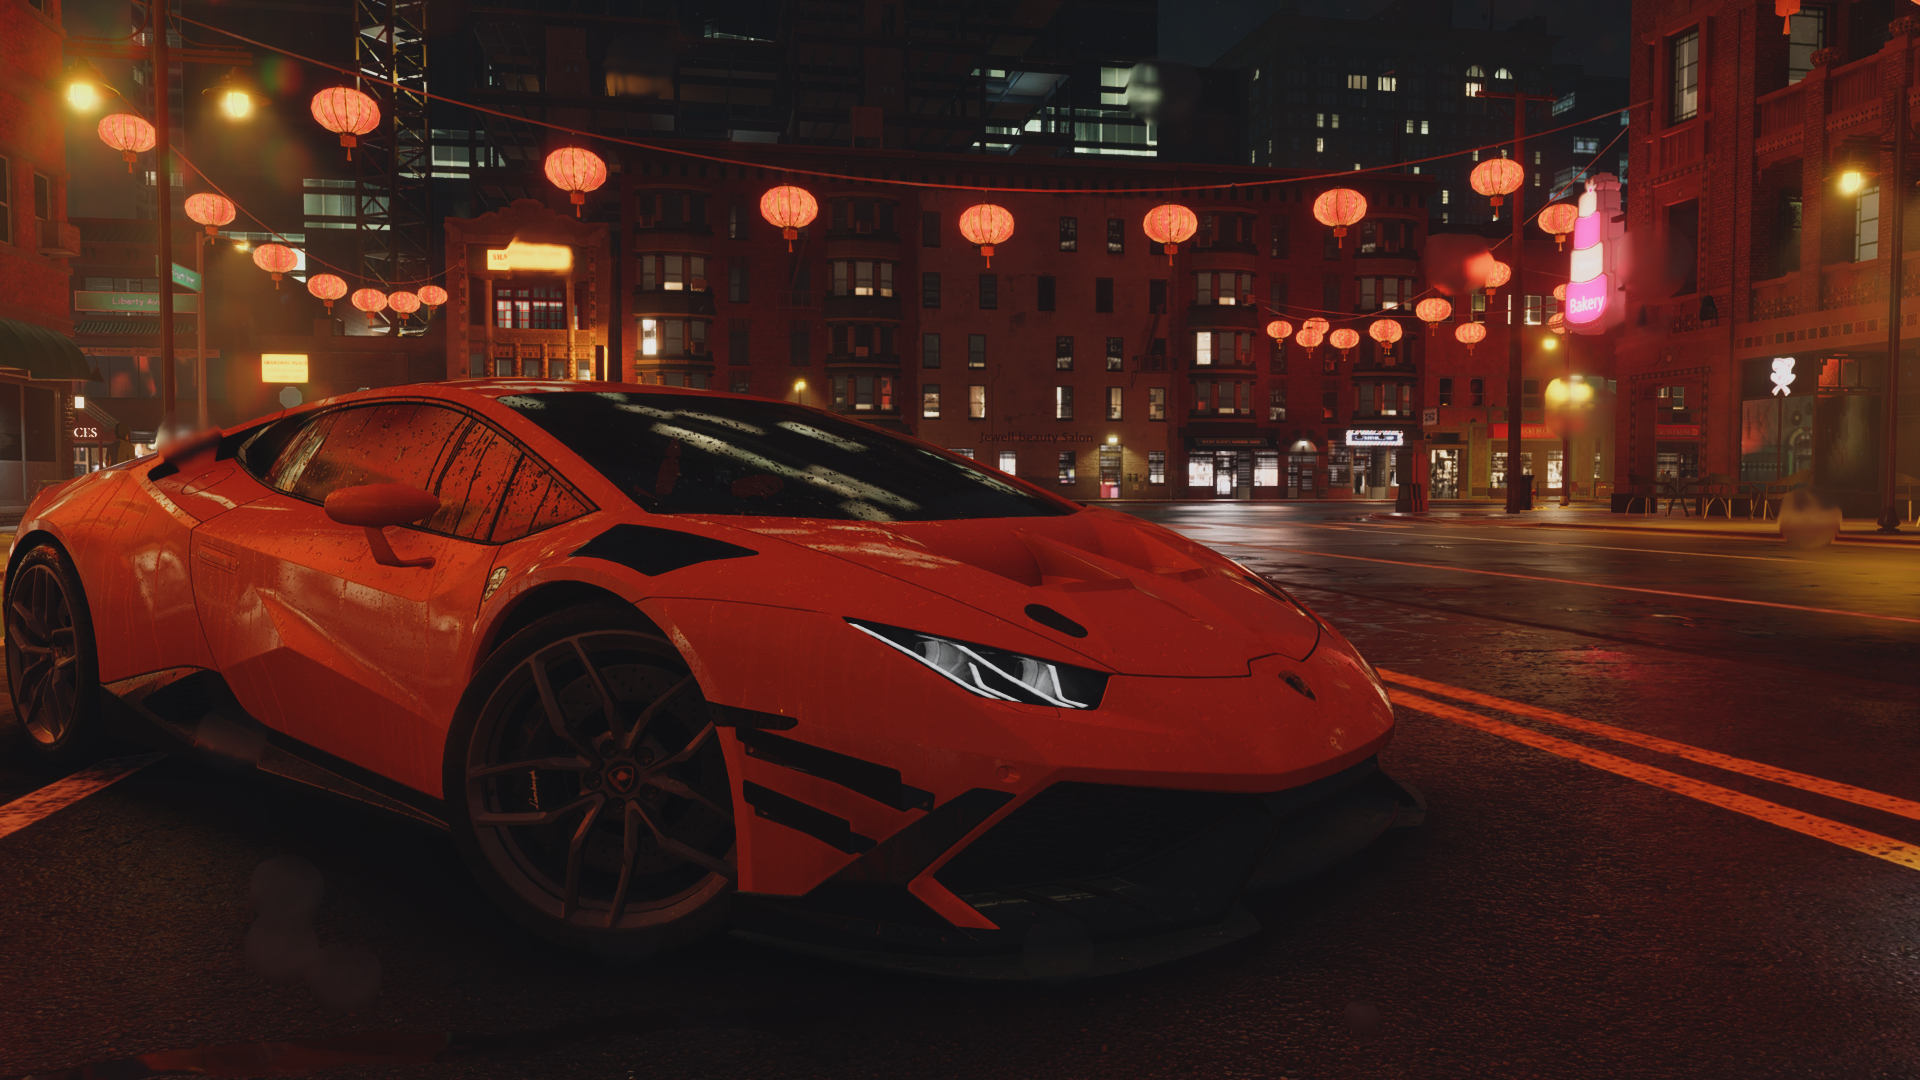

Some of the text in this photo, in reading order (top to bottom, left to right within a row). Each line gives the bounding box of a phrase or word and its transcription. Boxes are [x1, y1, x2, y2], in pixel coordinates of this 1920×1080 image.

[1574, 258, 1600, 272] Chinese
[112, 297, 144, 307] Liberty
[1570, 295, 1605, 314] Bakery
[978, 432, 1093, 444] Jewell beauty Salon
